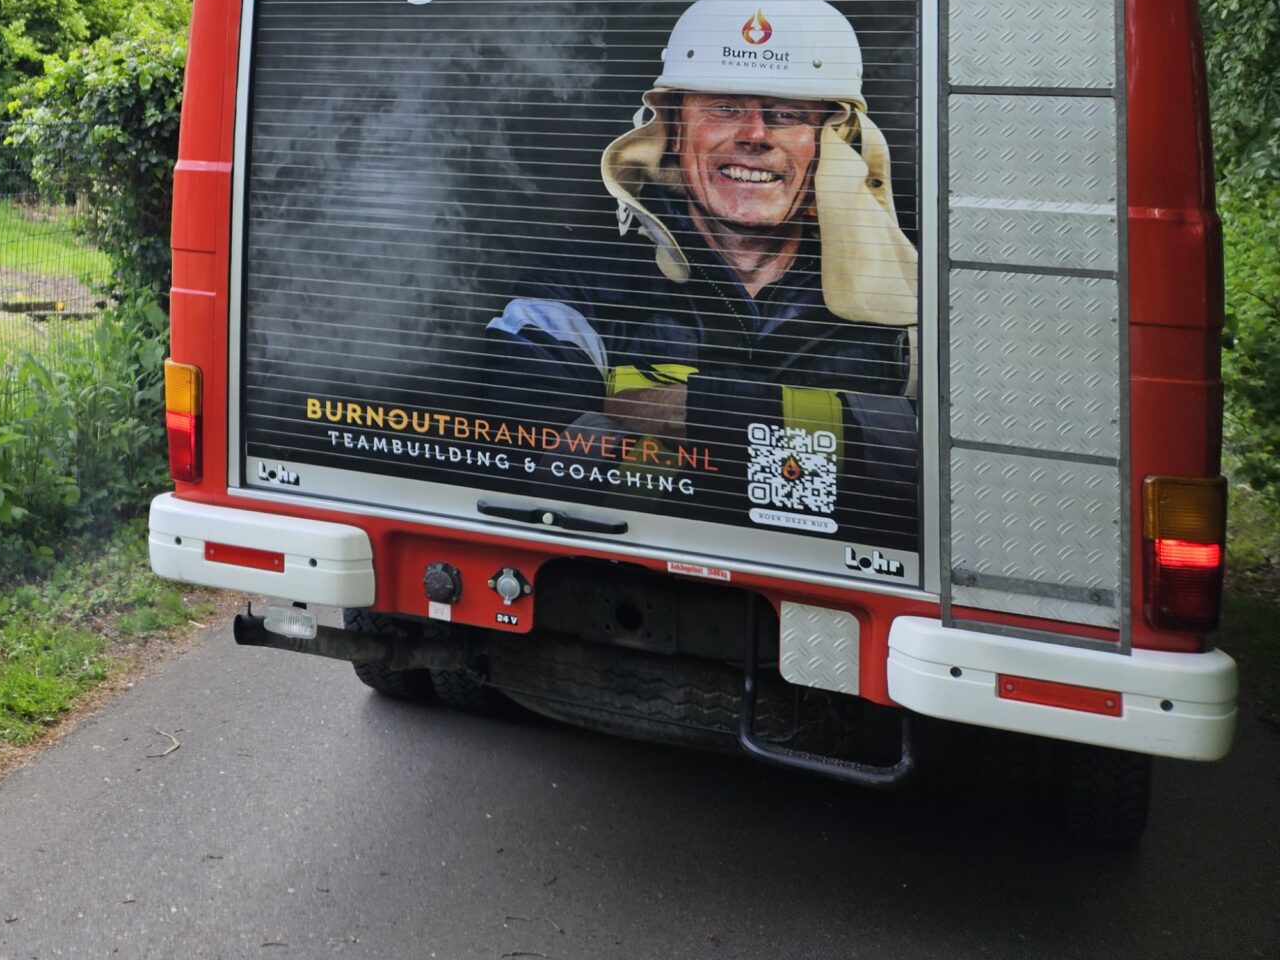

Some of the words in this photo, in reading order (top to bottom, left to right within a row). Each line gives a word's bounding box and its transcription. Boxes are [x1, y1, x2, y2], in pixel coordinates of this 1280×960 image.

[721, 60, 789, 71] BRANDWEER
[722, 46, 757, 60] Burn
[761, 49, 790, 62] Out
[306, 398, 719, 472] BURNOUTBRANDWEER.NL
[257, 461, 300, 487] Lohr
[327, 430, 510, 470] TEAMBUILDING
[524, 457, 537, 473] &
[550, 461, 696, 496] COACHING
[845, 546, 905, 578] Lohr
[497, 613, 509, 624] 24
[510, 616, 518, 625] V
